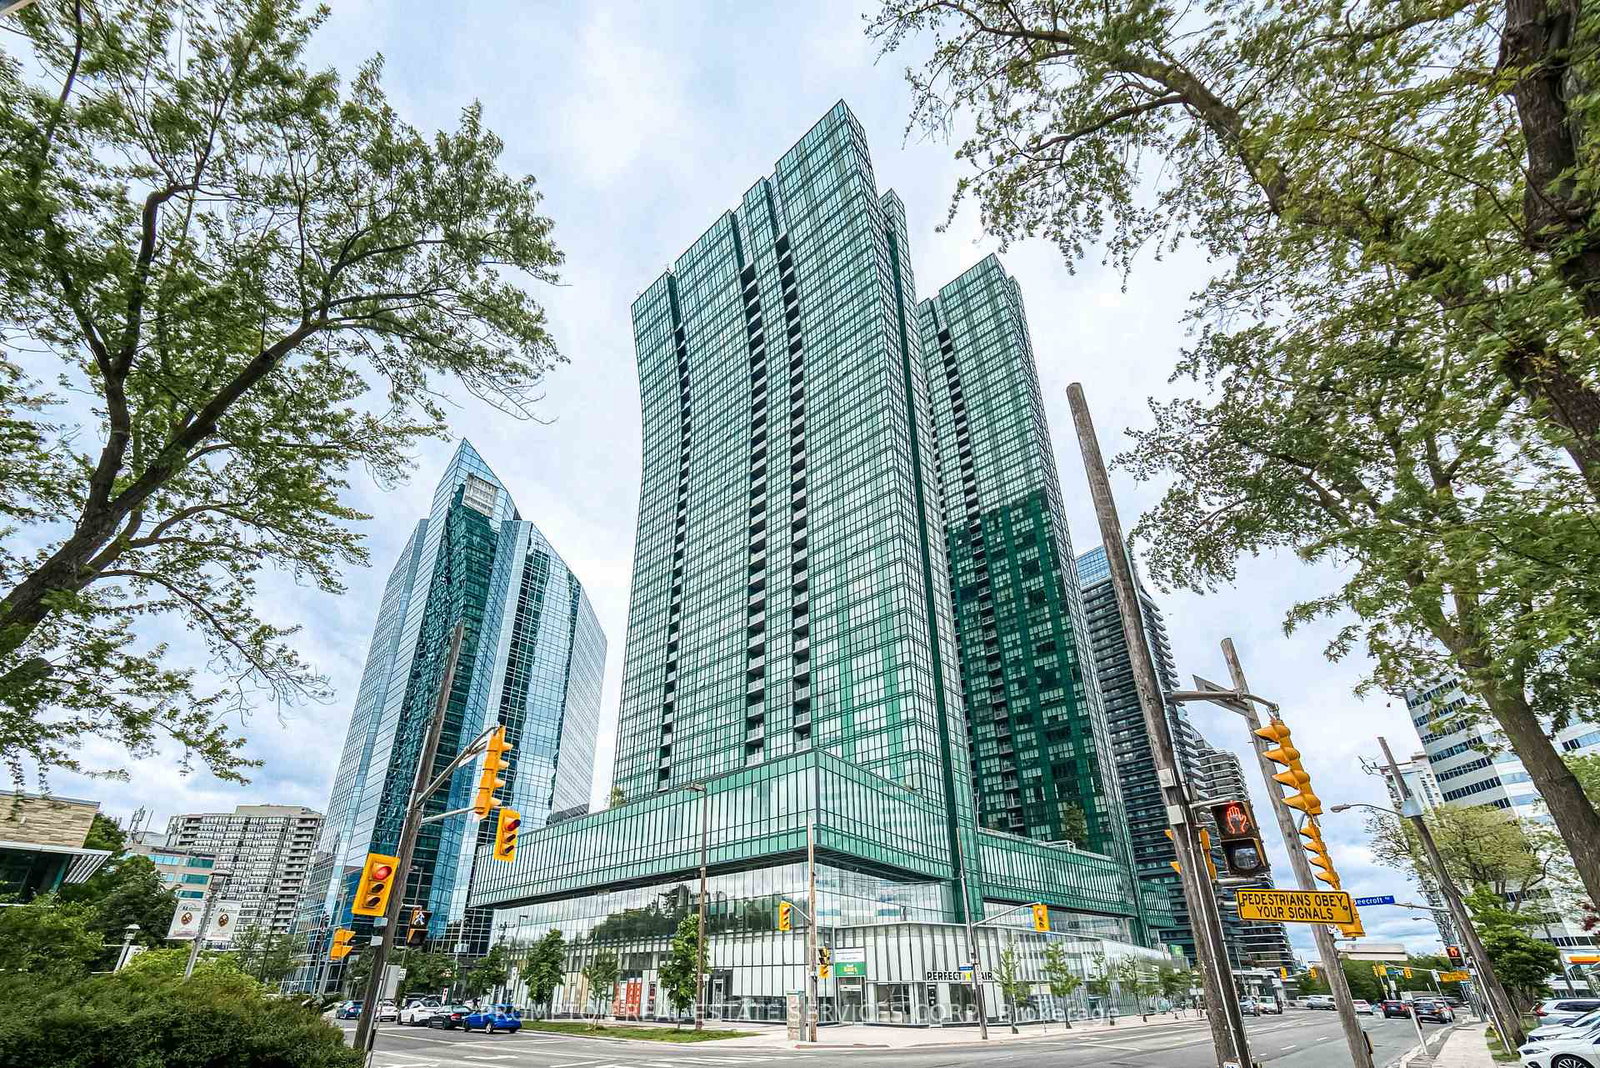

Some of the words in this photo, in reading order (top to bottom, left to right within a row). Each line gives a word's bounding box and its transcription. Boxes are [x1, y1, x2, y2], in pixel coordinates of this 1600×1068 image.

[1242, 893, 1312, 907] PEDESTRIANS
[1314, 894, 1344, 907] OBEY
[1354, 896, 1384, 906] eecroft
[1256, 906, 1285, 918] YOUR
[1288, 906, 1334, 920] SIGNALS
[926, 971, 961, 981] PERFECT
